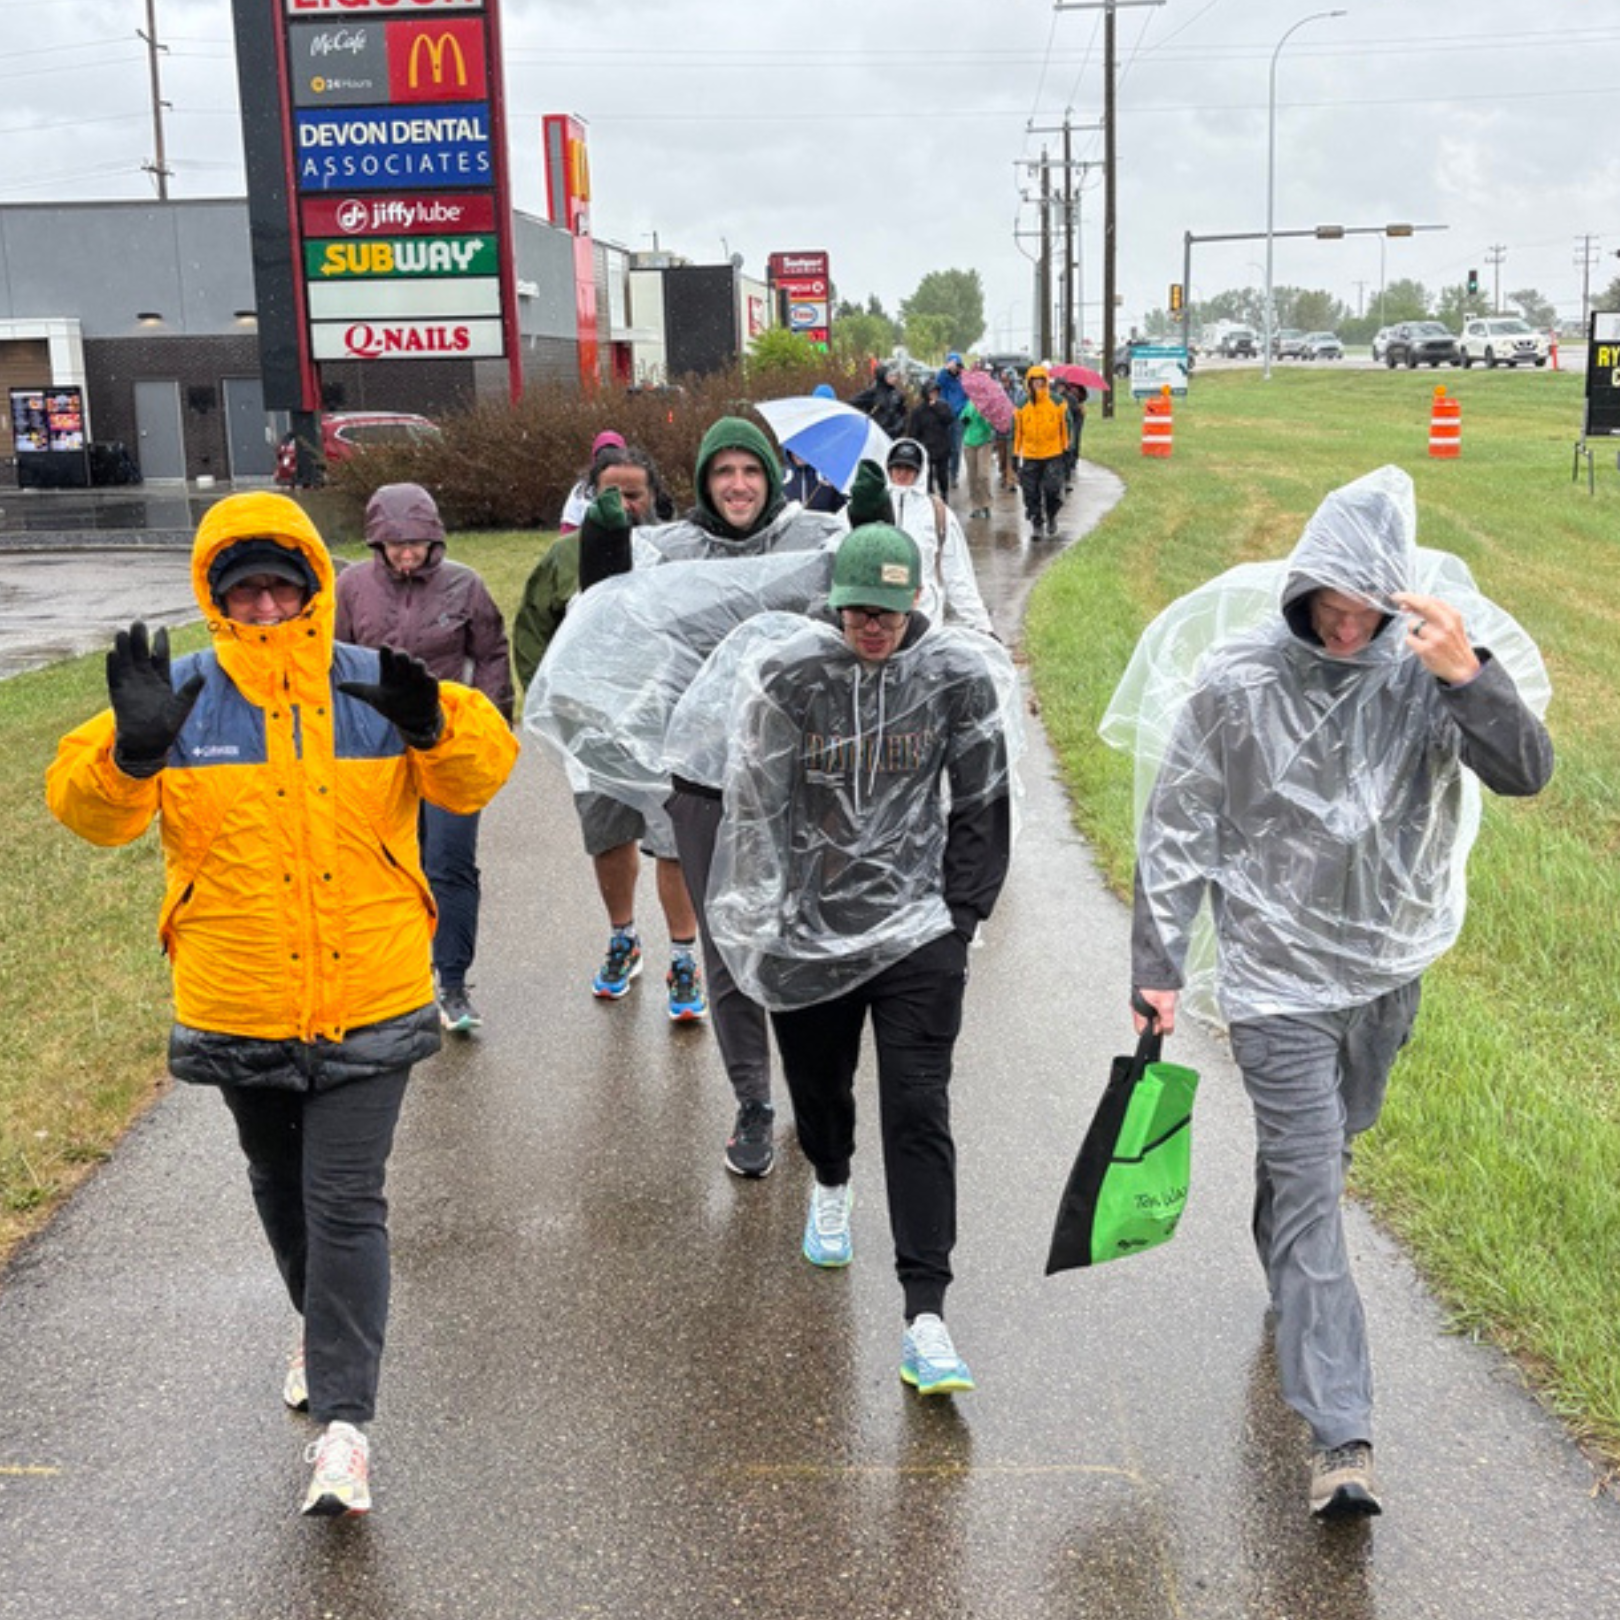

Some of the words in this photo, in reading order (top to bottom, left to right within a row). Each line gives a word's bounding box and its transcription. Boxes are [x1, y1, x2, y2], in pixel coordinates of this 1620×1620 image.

[300, 121, 388, 148] DEVON
[391, 117, 488, 144] DENTAL
[303, 151, 490, 177] ASSOCIATES
[320, 238, 484, 276] SUBWAY
[345, 322, 470, 359] Q-NAILS
